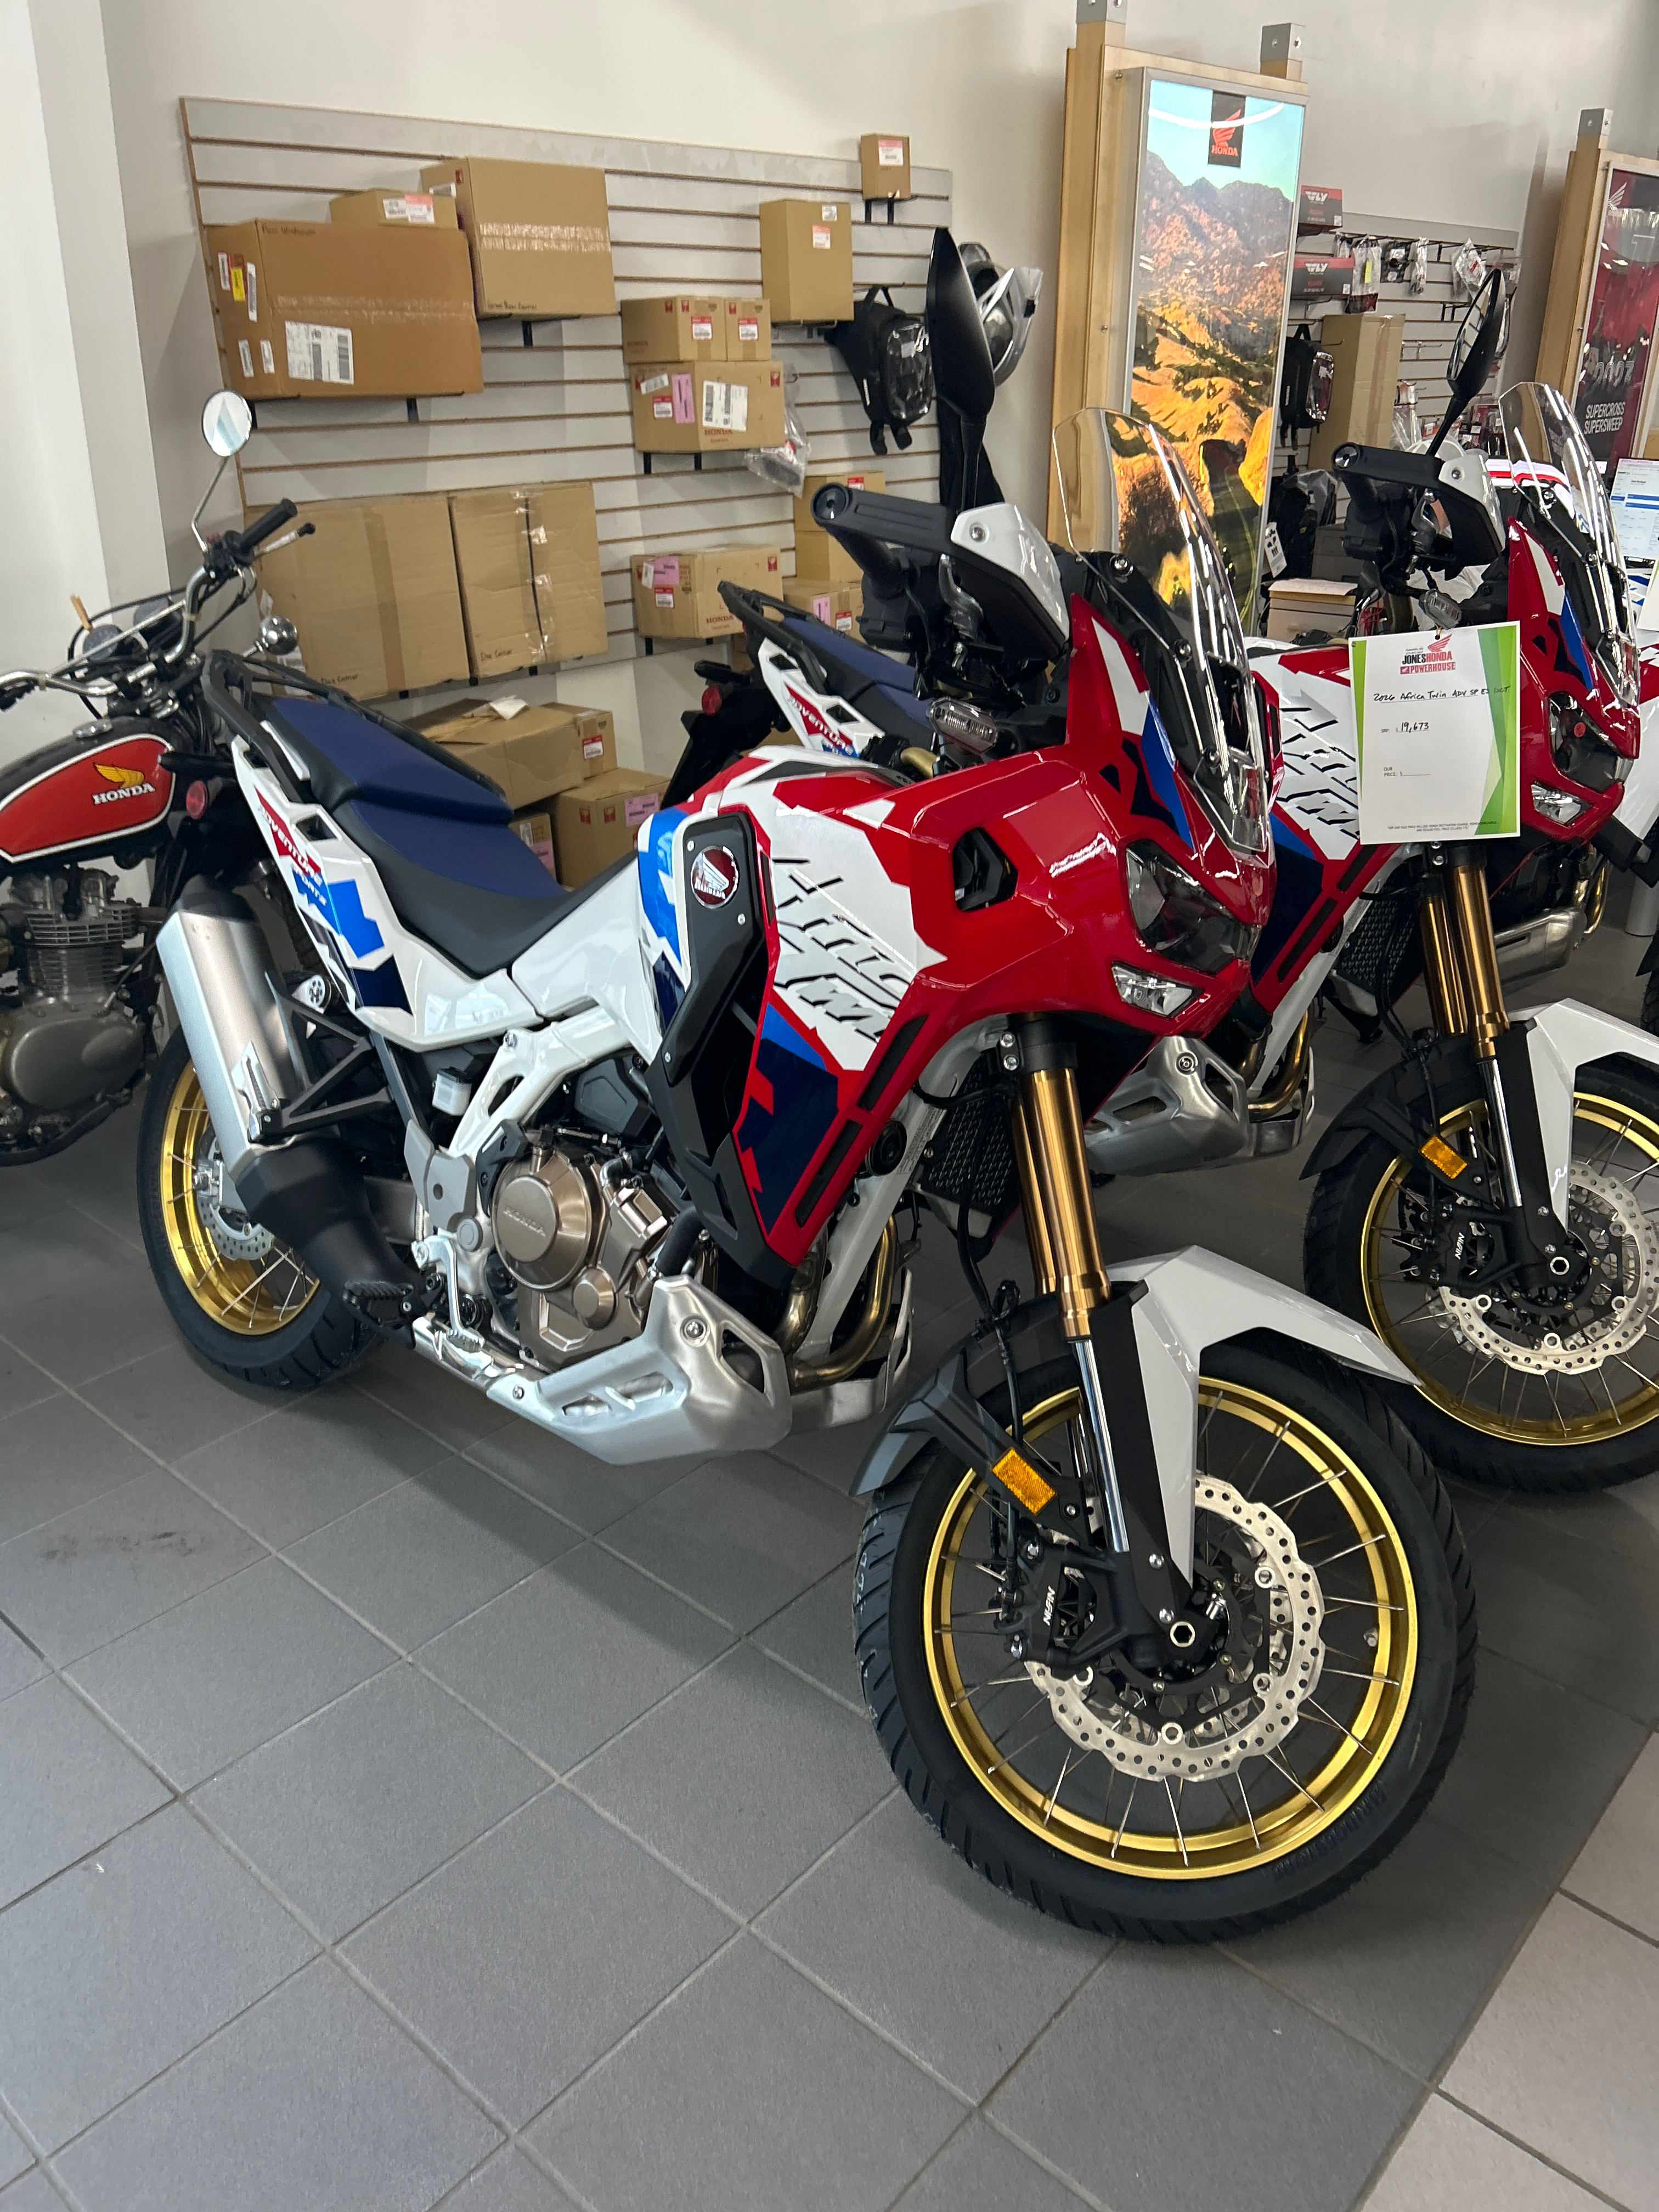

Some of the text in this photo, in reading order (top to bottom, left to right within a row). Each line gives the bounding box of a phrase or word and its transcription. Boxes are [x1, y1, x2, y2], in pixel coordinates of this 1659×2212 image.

[1211, 145, 1238, 156] HONDA
[1585, 401, 1626, 419] SUPERCROSS
[1584, 416, 1623, 435] SUPERSWEEP
[706, 615, 734, 623] HONDA
[1410, 662, 1455, 673] POWERHOUSE
[1373, 693, 1395, 702] 2026
[1400, 691, 1425, 699] Africa
[1427, 690, 1446, 699] Twin
[787, 695, 854, 756] ADVENTURE
[1401, 722, 1429, 733] 19,673
[91, 782, 155, 805] HONDA
[258, 804, 323, 888] ADVENTURE
[504, 1205, 546, 1237] HONDA
